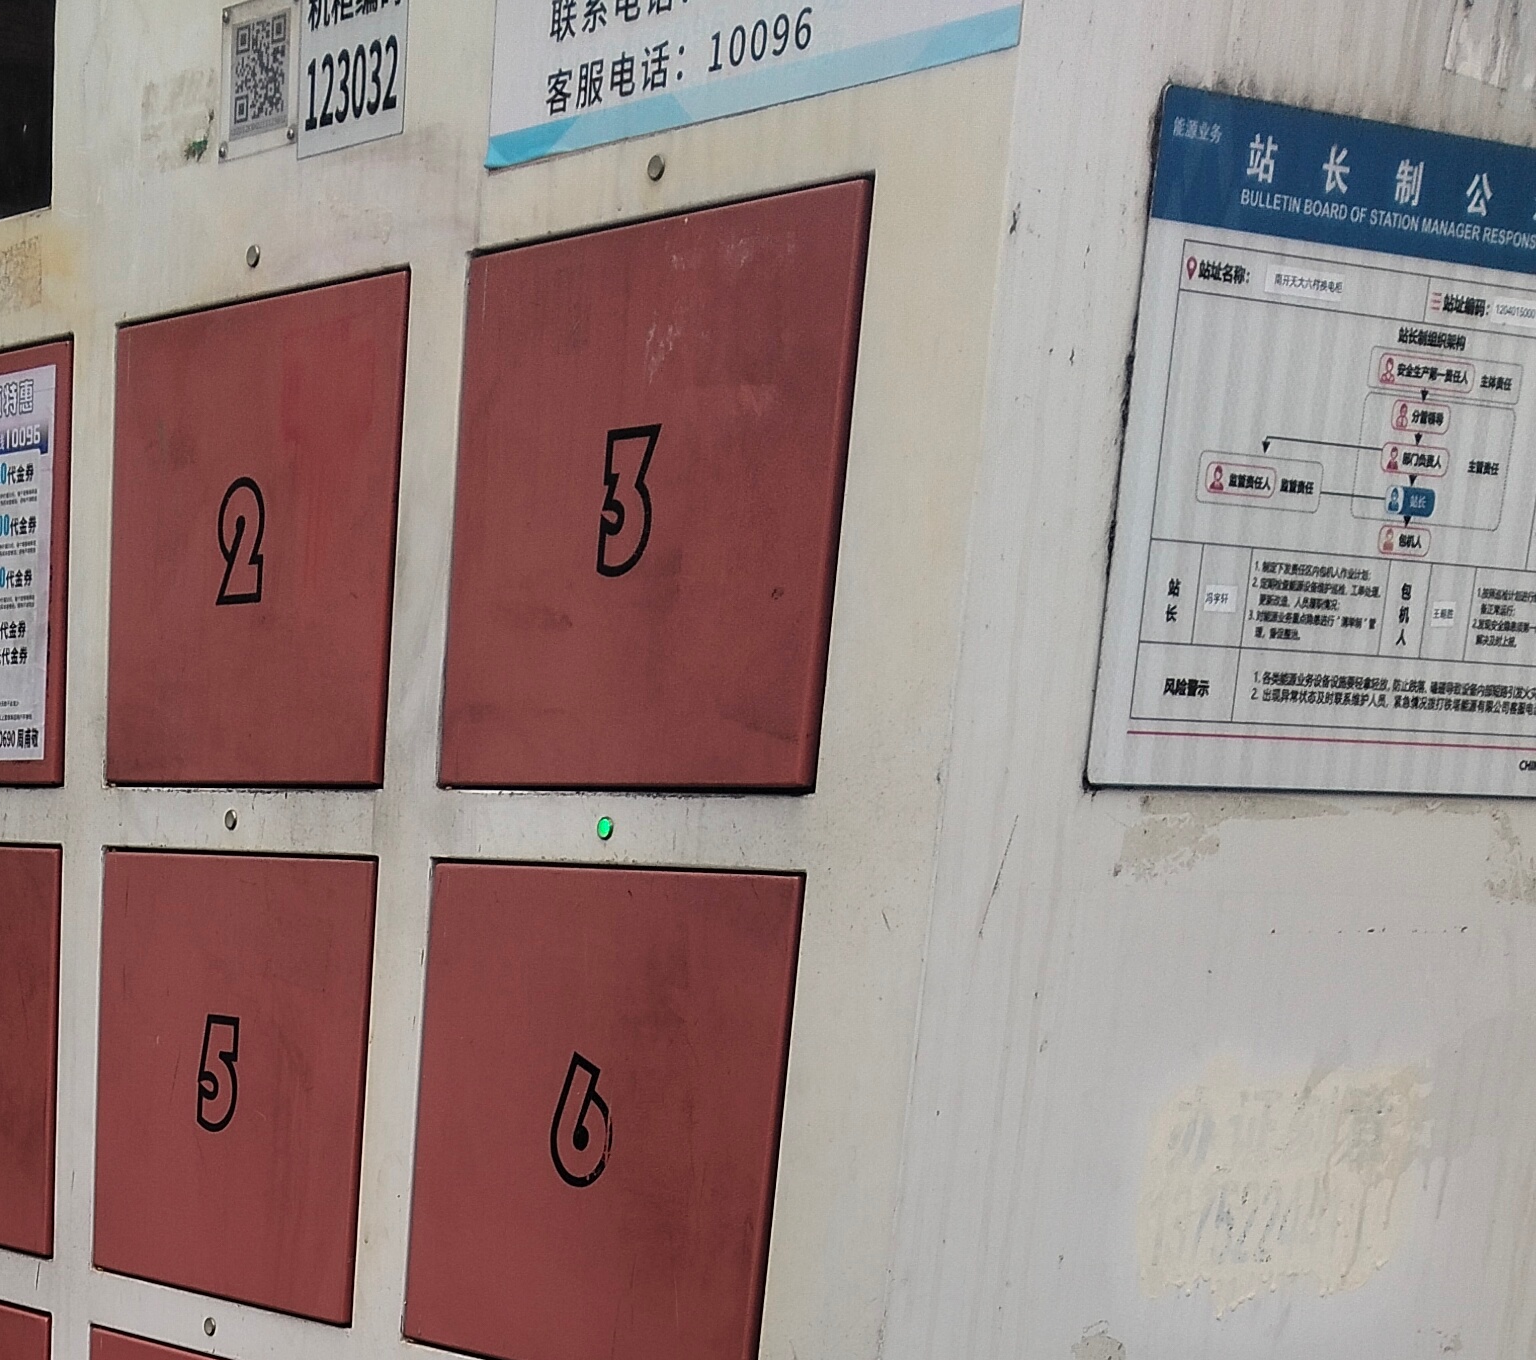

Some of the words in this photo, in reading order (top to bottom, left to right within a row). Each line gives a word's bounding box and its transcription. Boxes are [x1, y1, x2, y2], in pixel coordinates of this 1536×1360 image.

[308, 0, 400, 32] 机柜
[305, 35, 398, 132] 123032
[1172, 116, 1223, 144] 能源业务
[1240, 187, 1302, 214] BULLETIN
[1303, 198, 1348, 221] BOARD
[1350, 205, 1368, 223] OF
[1369, 208, 1420, 232] STATION
[1421, 217, 1481, 241] MANAGER
[1247, 132, 1536, 222] 站长制公
[216, 477, 265, 606] 2
[596, 423, 662, 578] 3
[1163, 677, 1210, 698] 风险警示
[197, 1014, 240, 1132] 5
[550, 1051, 613, 1188] 6
